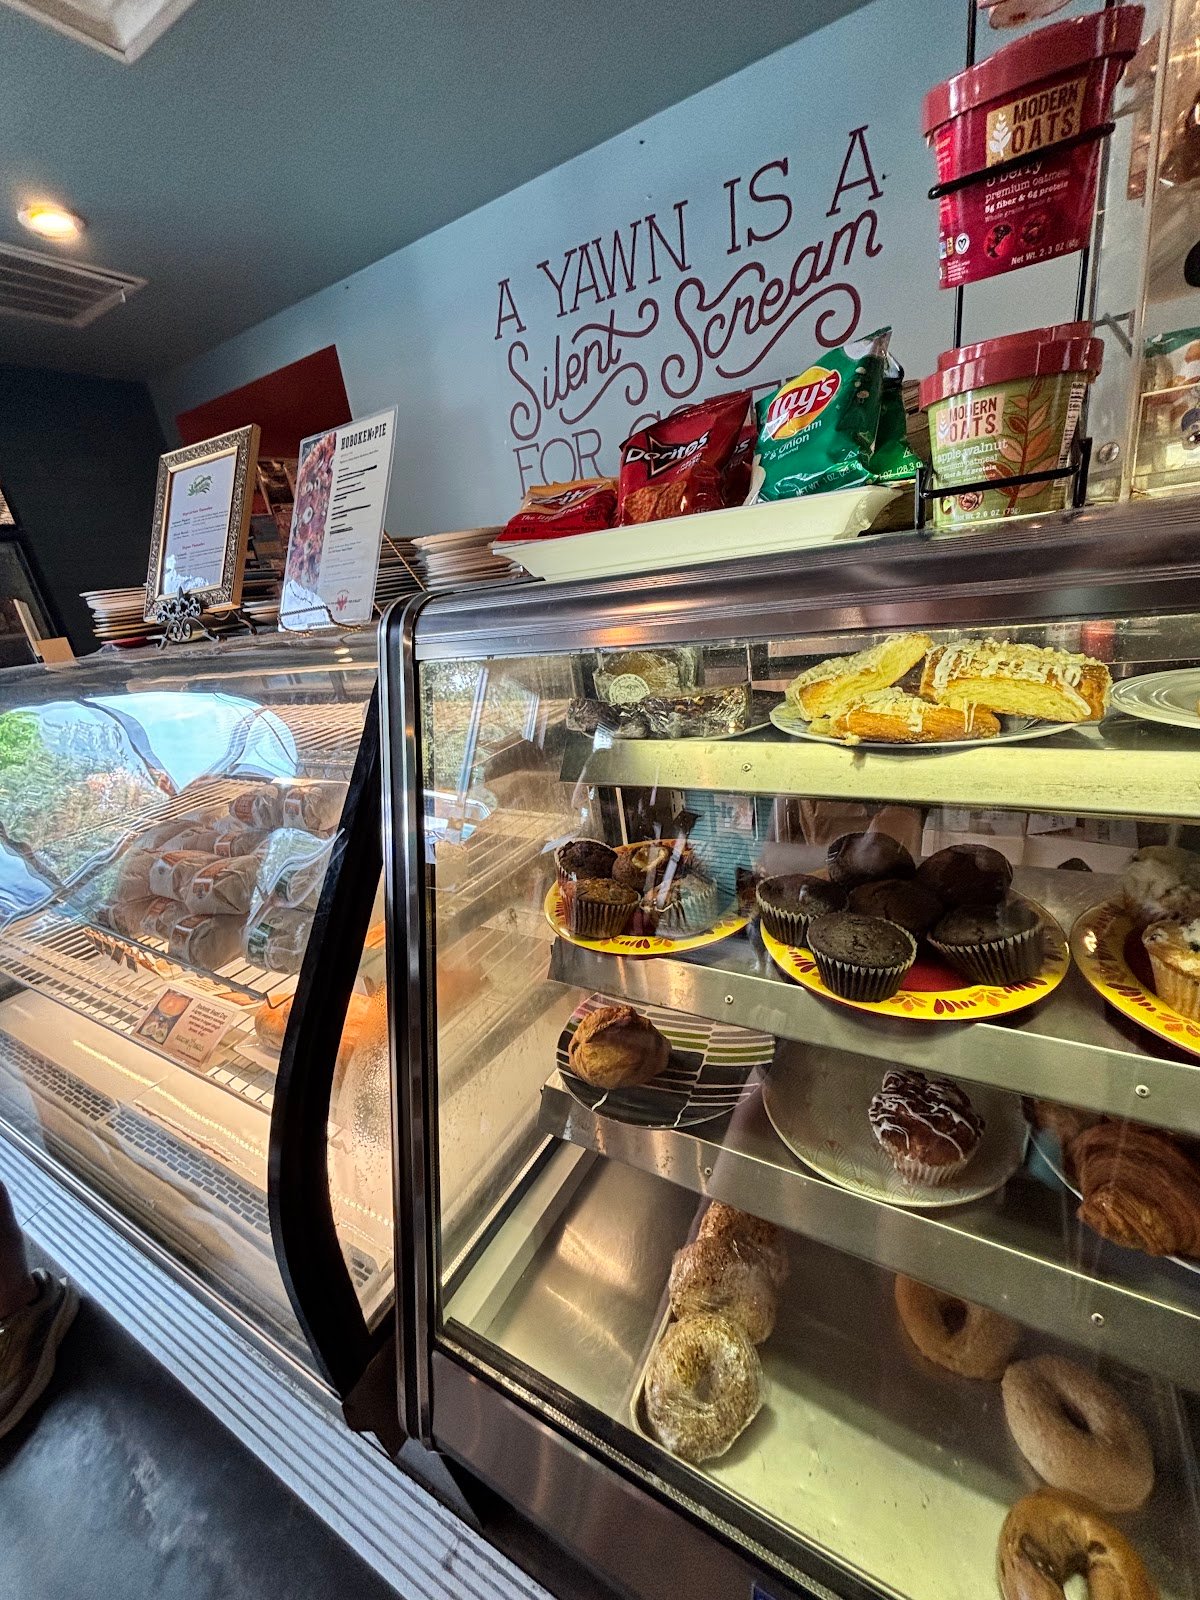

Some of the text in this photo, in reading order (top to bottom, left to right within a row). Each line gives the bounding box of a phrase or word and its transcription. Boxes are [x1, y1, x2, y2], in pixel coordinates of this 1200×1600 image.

[1014, 82, 1079, 126] MODERN
[1011, 106, 1076, 154] OATS
[985, 181, 1030, 205] premium
[996, 197, 1018, 210] fiber
[1039, 180, 1069, 197] protein
[494, 124, 884, 340] A YAWN IS A
[1010, 254, 1024, 266] Net
[1039, 245, 1053, 257] 2.3
[1055, 242, 1065, 252] OZ
[508, 209, 883, 441] Silent Scream
[771, 376, 837, 422] Lay's
[340, 422, 388, 450] HOBOKEN PIE
[949, 413, 997, 443] OATS
[625, 430, 710, 464] Doritos
[512, 428, 606, 501] FOR
[795, 487, 808, 497] NET
